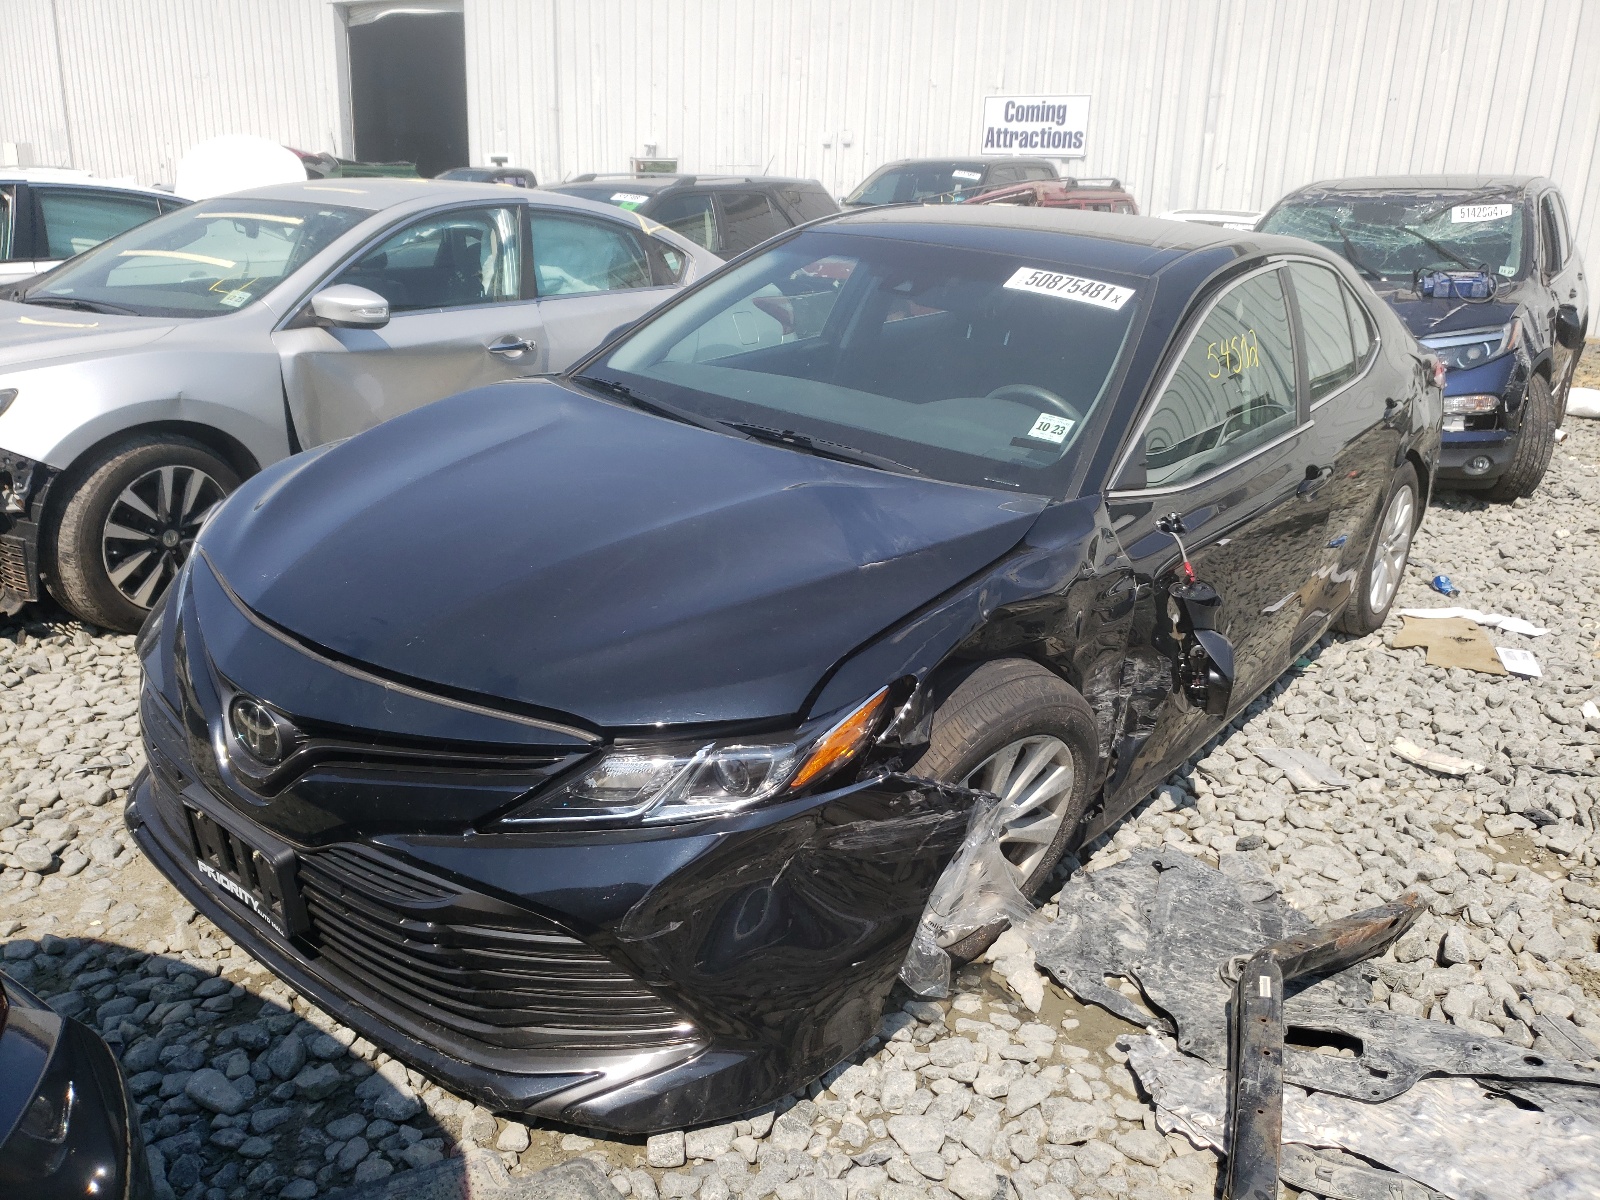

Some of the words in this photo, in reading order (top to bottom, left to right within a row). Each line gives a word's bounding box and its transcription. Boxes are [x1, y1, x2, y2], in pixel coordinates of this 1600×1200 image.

[1004, 100, 1067, 126] Coming
[984, 126, 1084, 149] Attractions
[1036, 421, 1051, 432] 10
[1050, 424, 1066, 436] 23
[197, 859, 259, 912] PRIORITY
